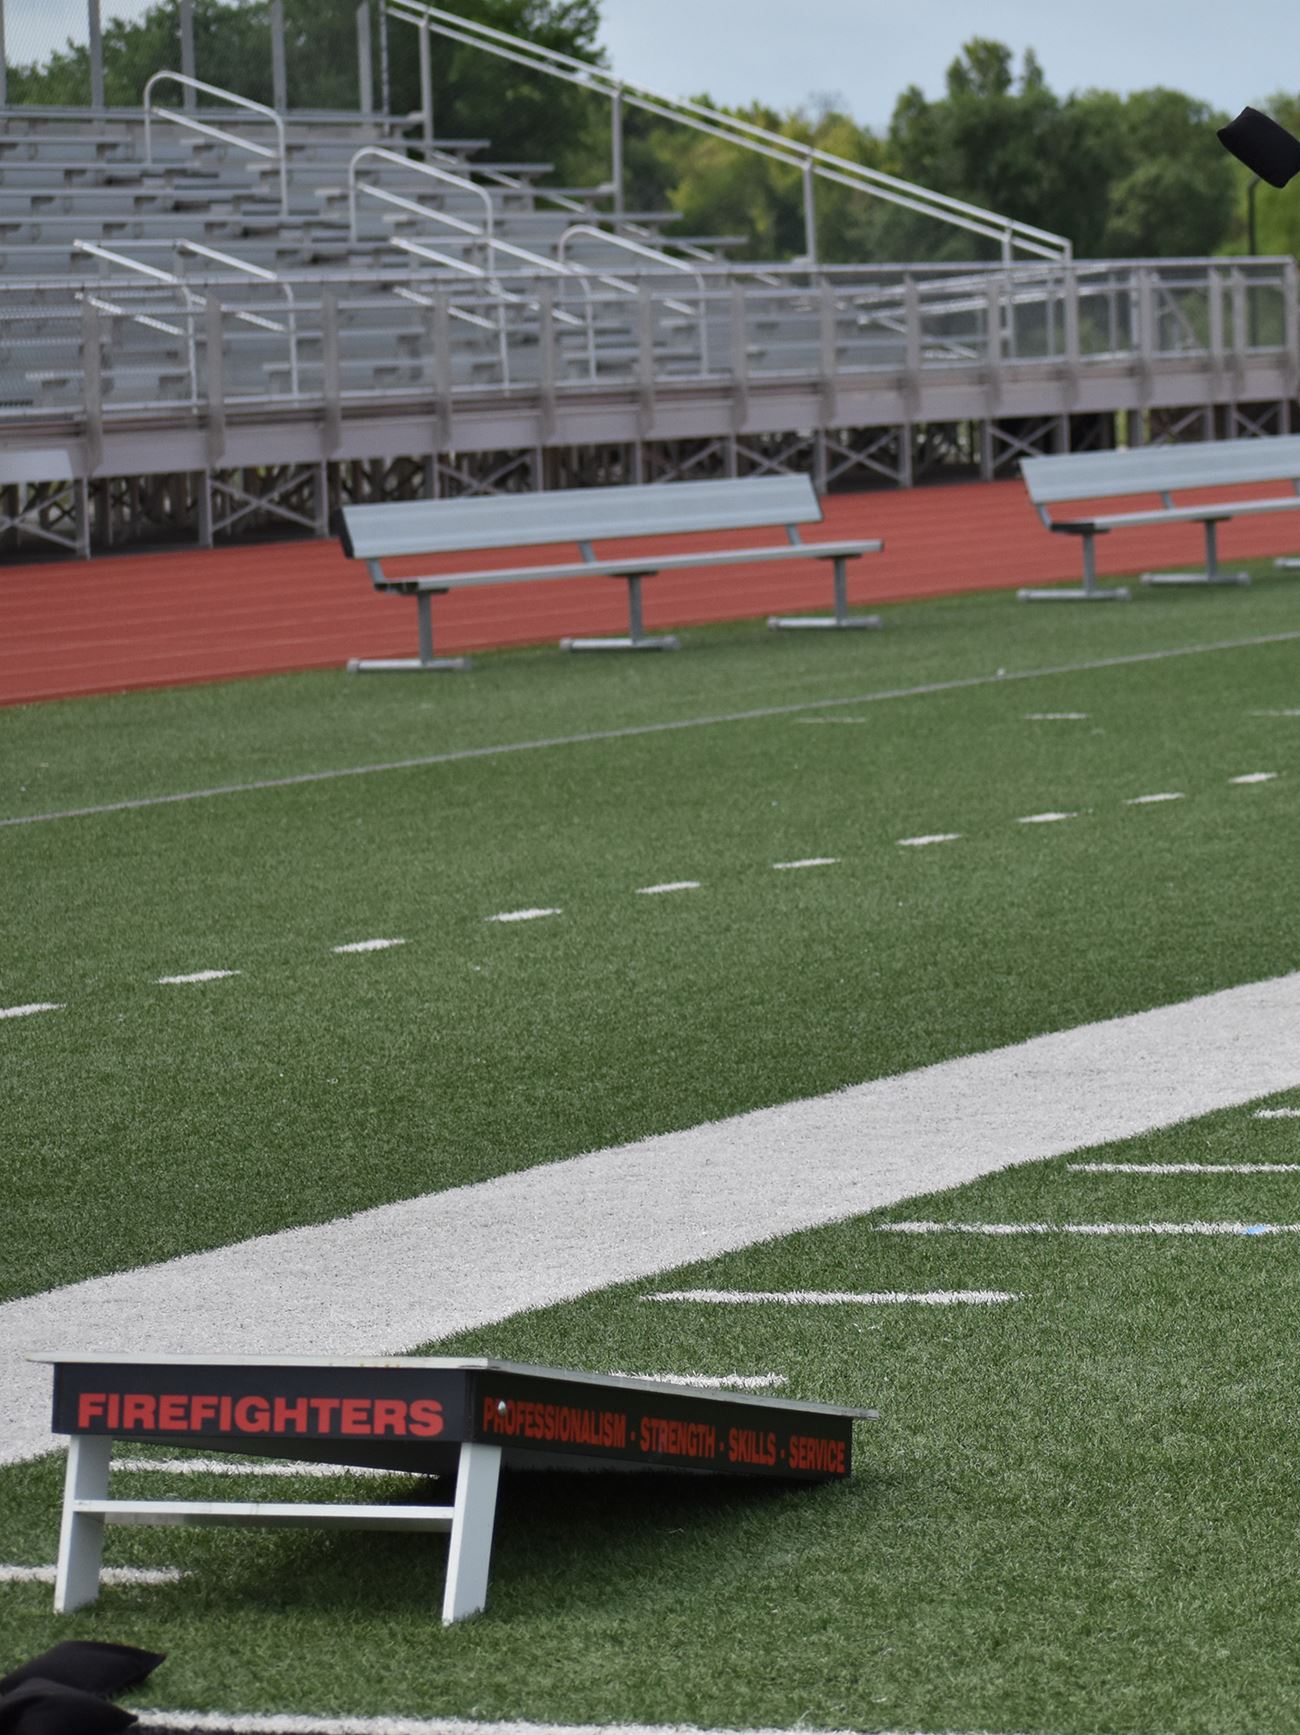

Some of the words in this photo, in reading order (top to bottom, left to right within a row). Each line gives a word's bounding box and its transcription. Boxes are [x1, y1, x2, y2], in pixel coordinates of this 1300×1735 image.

[77, 1393, 445, 1438] FIREFIGHTERS
[483, 1397, 626, 1449] PROFESSIONALISM
[640, 1417, 716, 1459] STRENGTH
[729, 1428, 777, 1466] SKILLS
[789, 1435, 846, 1473] SERVICE
